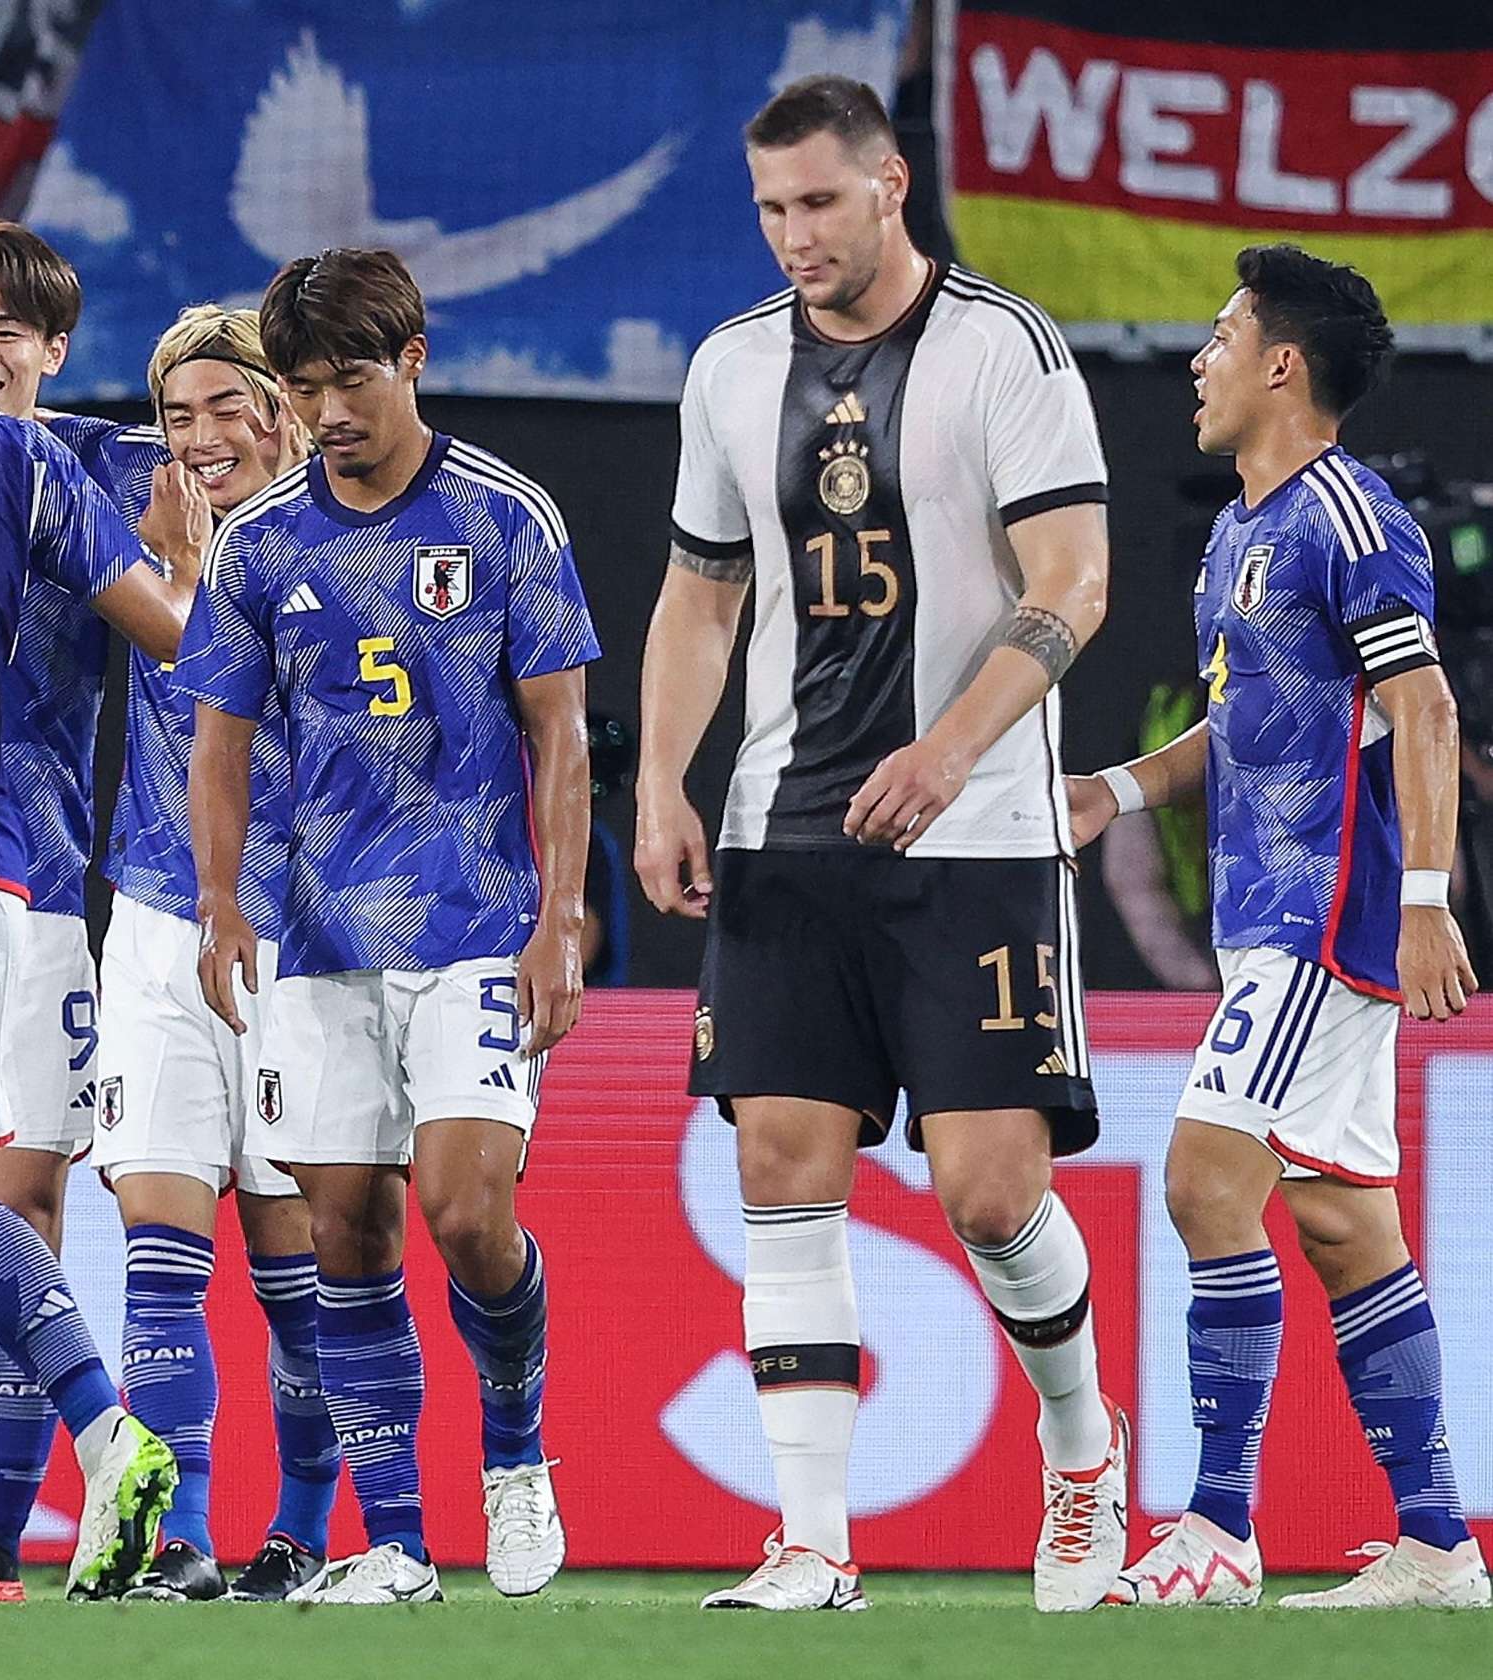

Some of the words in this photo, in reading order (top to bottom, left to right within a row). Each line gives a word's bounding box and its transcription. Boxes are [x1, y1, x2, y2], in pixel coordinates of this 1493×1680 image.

[806, 529, 898, 618] 15
[357, 636, 412, 717] 5
[478, 976, 520, 1053] 5
[978, 943, 1058, 1030] 15
[1210, 980, 1259, 1055] 6
[62, 990, 99, 1071] 9
[656, 1052, 1493, 1520] ST
